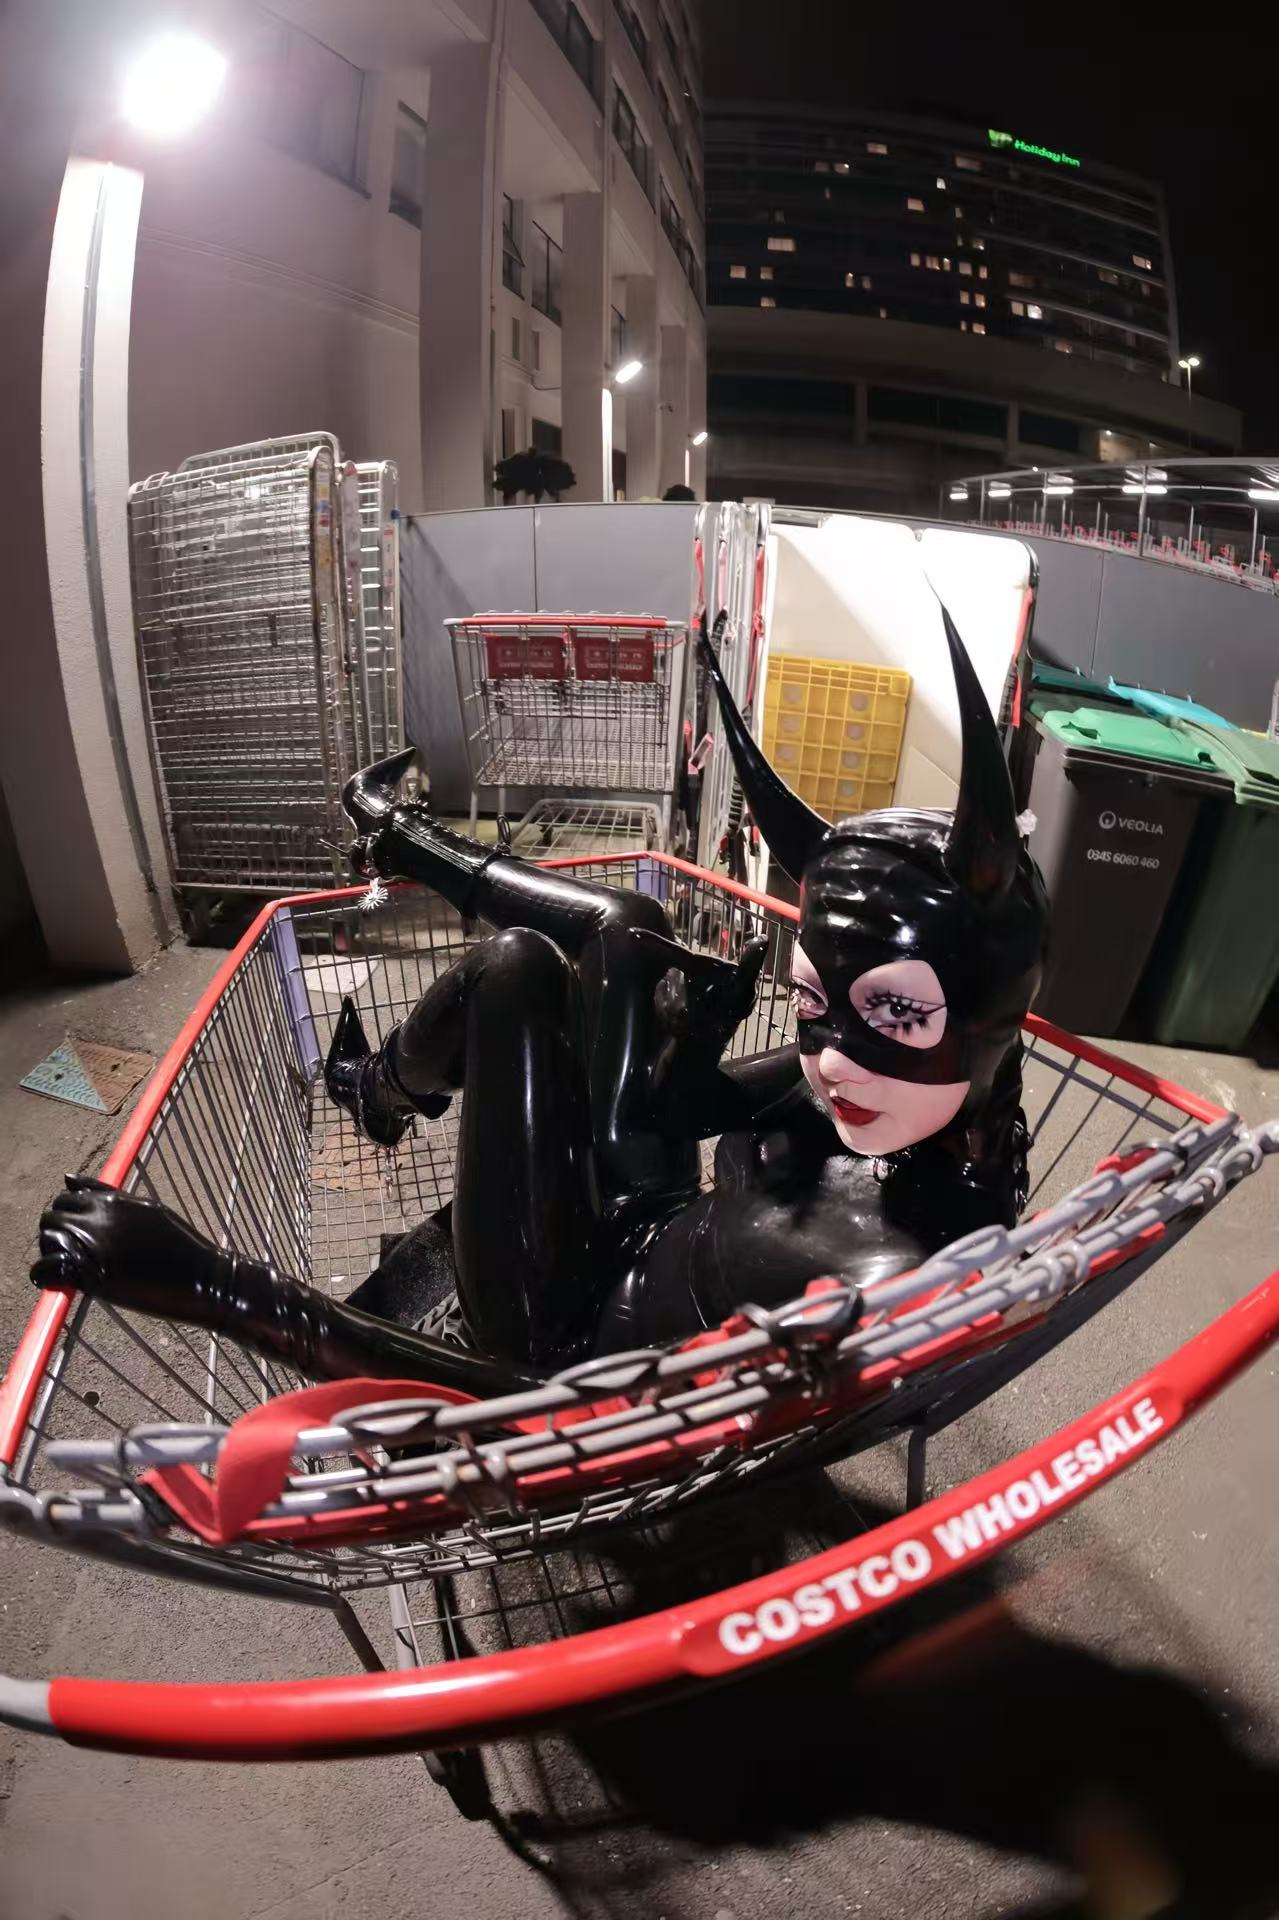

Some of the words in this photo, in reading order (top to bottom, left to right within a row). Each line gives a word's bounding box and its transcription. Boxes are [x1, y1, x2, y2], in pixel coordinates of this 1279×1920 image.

[1014, 139, 1061, 162] Holiday
[1118, 817, 1163, 834] VEOLIA
[1087, 848, 1112, 861] 0345
[1113, 853, 1139, 866] 6060
[1140, 857, 1160, 869] 460
[718, 1539, 933, 1656] COSTCO
[932, 1397, 1165, 1560] WHOLESALE
